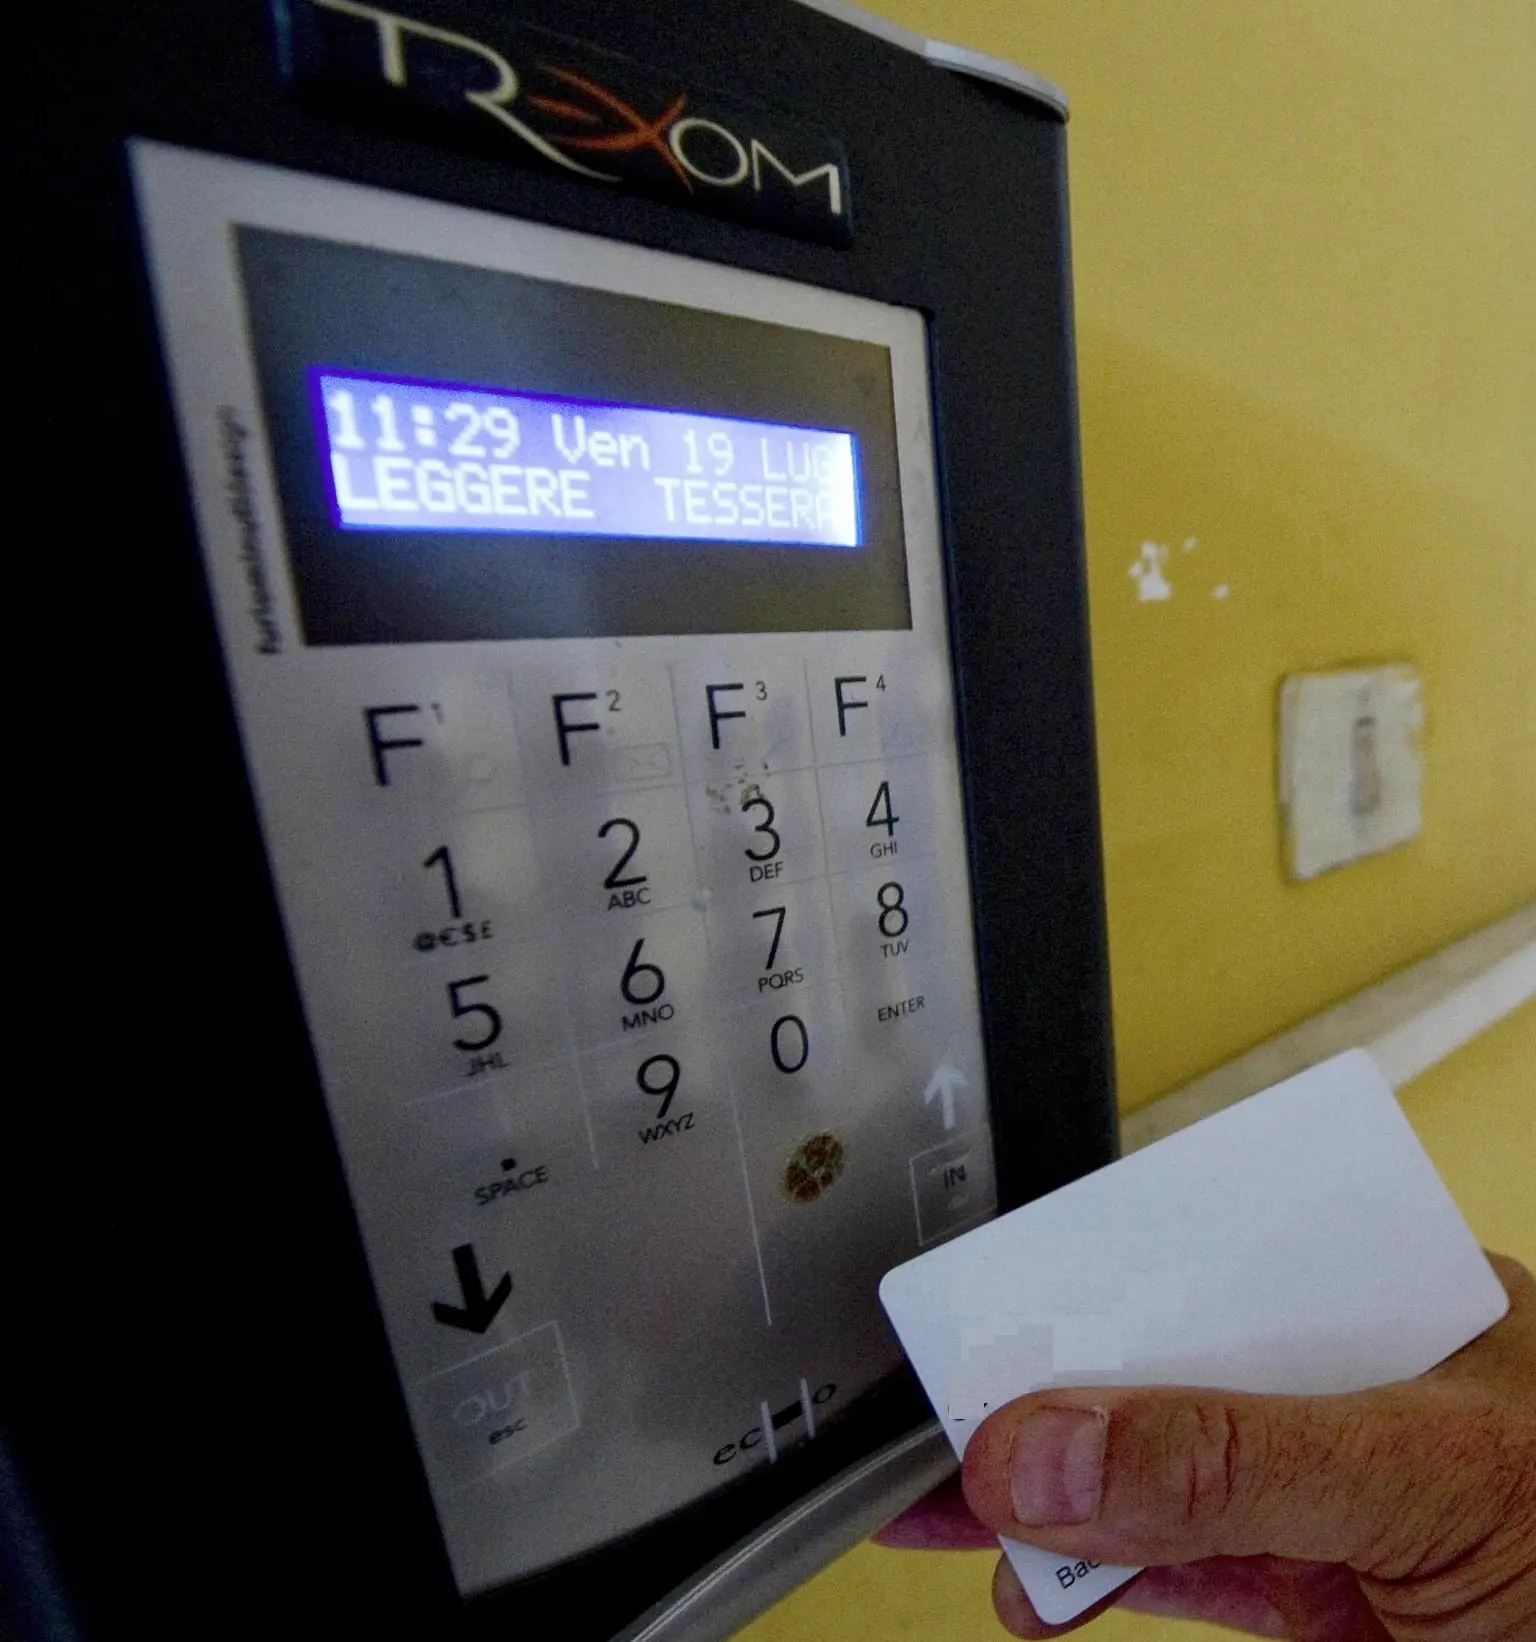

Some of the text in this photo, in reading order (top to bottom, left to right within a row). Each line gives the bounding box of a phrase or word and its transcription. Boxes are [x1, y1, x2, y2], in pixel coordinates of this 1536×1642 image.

[312, 0, 843, 217] TREXOM
[330, 390, 838, 484] 11:29 Ven 19 LUG
[331, 452, 595, 518] LEGGERE
[741, 798, 781, 861] 3
[866, 780, 900, 837] 4
[598, 817, 647, 889] 2
[749, 861, 785, 883] DEF
[870, 841, 898, 859] GHI
[423, 846, 463, 919] 1
[607, 887, 653, 911] ABC
[876, 881, 909, 938] 8
[753, 906, 786, 970] 7
[880, 939, 910, 959] TUV
[620, 938, 665, 1005] 6
[758, 967, 805, 993] PQRS
[448, 974, 503, 1051] 5
[621, 1003, 674, 1031] MNO
[877, 995, 926, 1022] ENTER
[770, 1014, 809, 1074] 0
[636, 1054, 681, 1119] 9
[637, 1111, 695, 1145] WXYZ
[473, 1165, 549, 1207] SPACE
[943, 1164, 967, 1191] IN
[489, 1417, 528, 1445] esc
